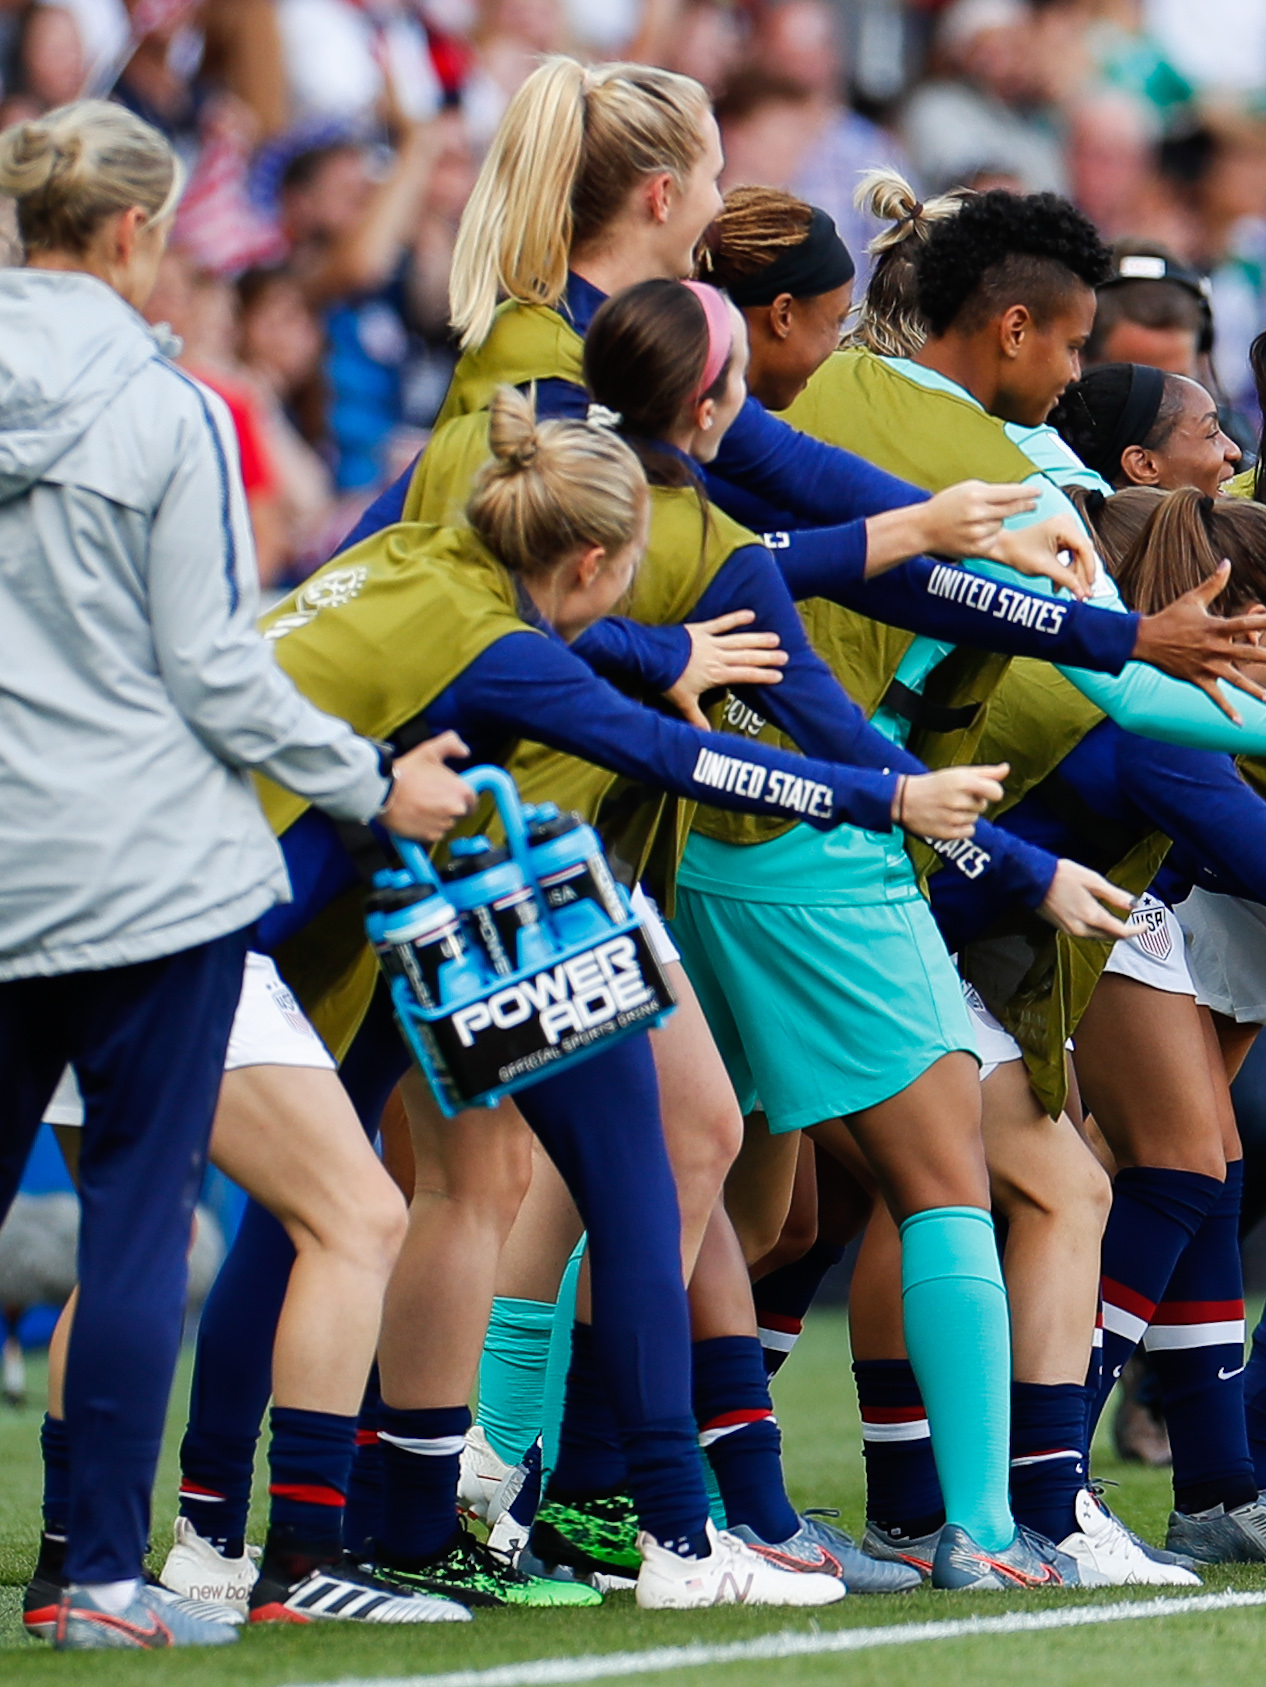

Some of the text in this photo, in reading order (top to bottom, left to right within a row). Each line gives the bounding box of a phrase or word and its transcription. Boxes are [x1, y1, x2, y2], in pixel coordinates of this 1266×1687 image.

[927, 565, 1067, 635] UNITED STATES
[693, 748, 833, 819] UNITED STATES
[924, 836, 991, 879] ATES
[452, 935, 638, 1047] POWER
[540, 969, 652, 1045] ADE
[189, 1584, 225, 1600] new
